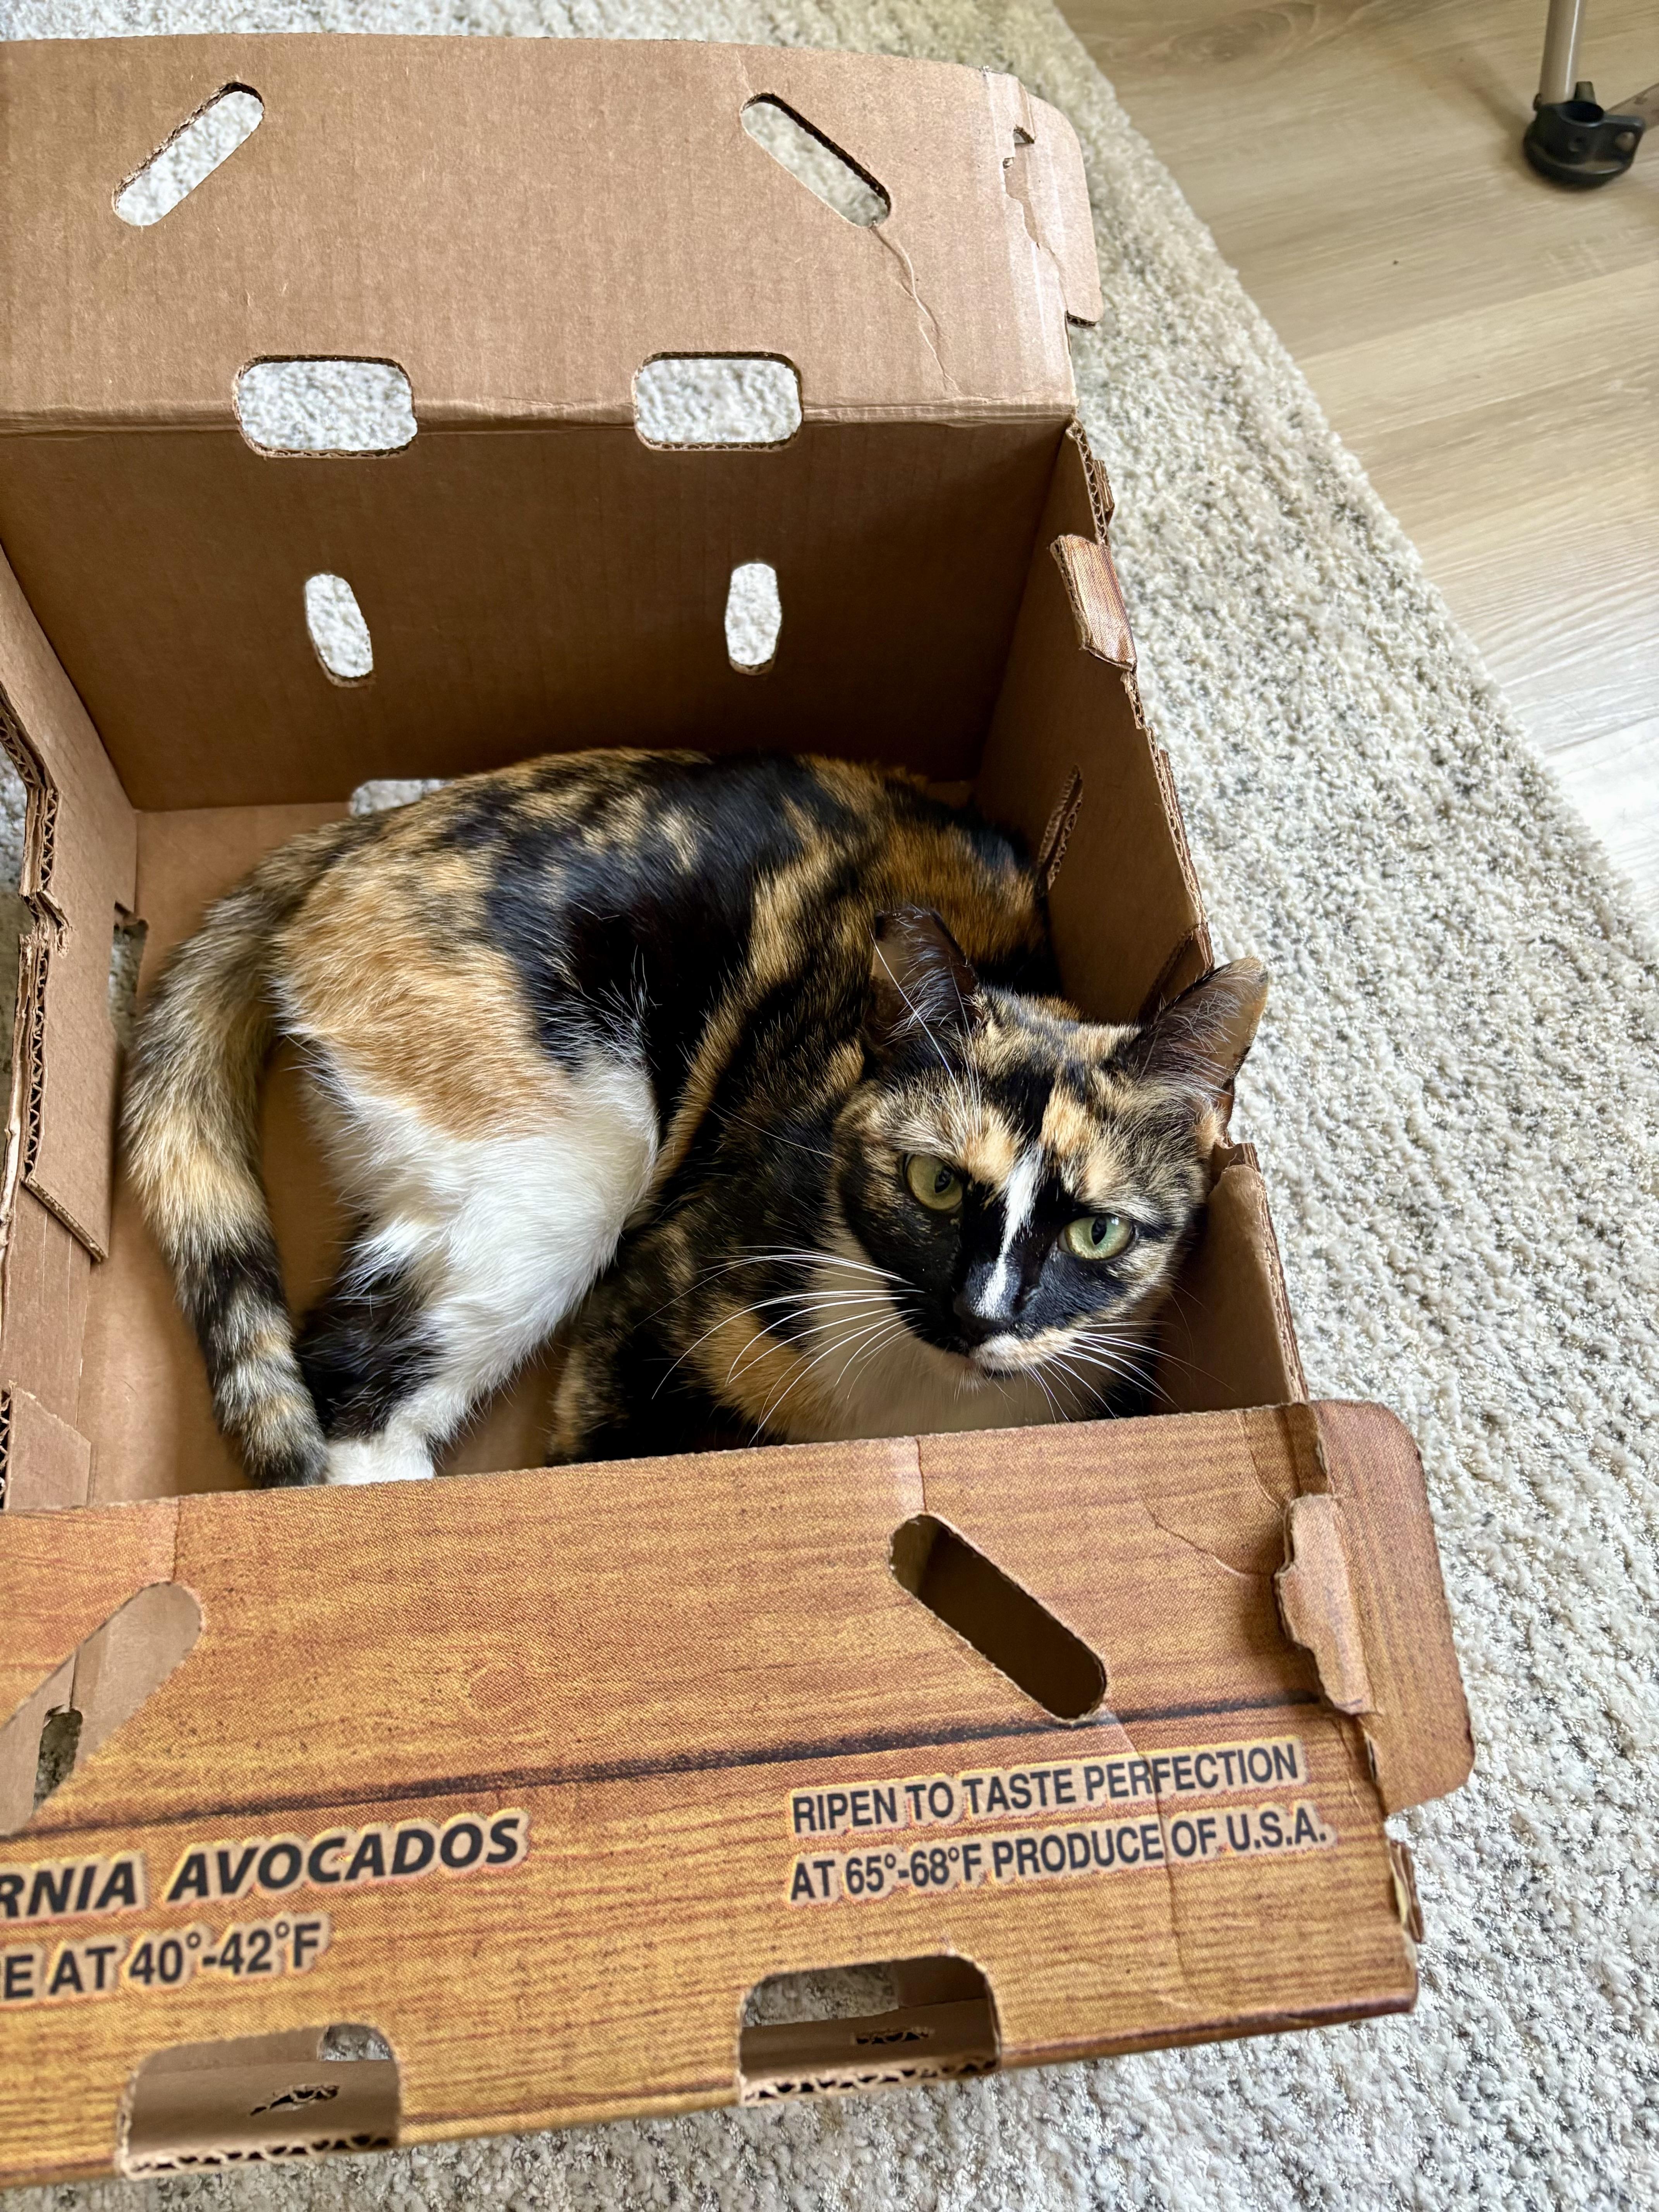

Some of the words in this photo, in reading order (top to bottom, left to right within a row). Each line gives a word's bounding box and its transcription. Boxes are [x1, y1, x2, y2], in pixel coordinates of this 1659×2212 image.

[792, 1787, 897, 1833] RIPEN
[905, 1782, 954, 1820] TO
[962, 1769, 1076, 1814] TASTE
[1084, 1744, 1298, 1801] PERFECTION
[168, 1819, 519, 1901] AVOCADOS
[791, 1860, 835, 1900] AT
[846, 1843, 982, 1894] 65°-68°F
[992, 1824, 1164, 1877] PRODUCE
[1171, 1818, 1216, 1857] OF
[1227, 1808, 1326, 1850] U.S.A.
[49, 1946, 116, 1995] AT
[130, 1920, 321, 1984] 40°-42°F
